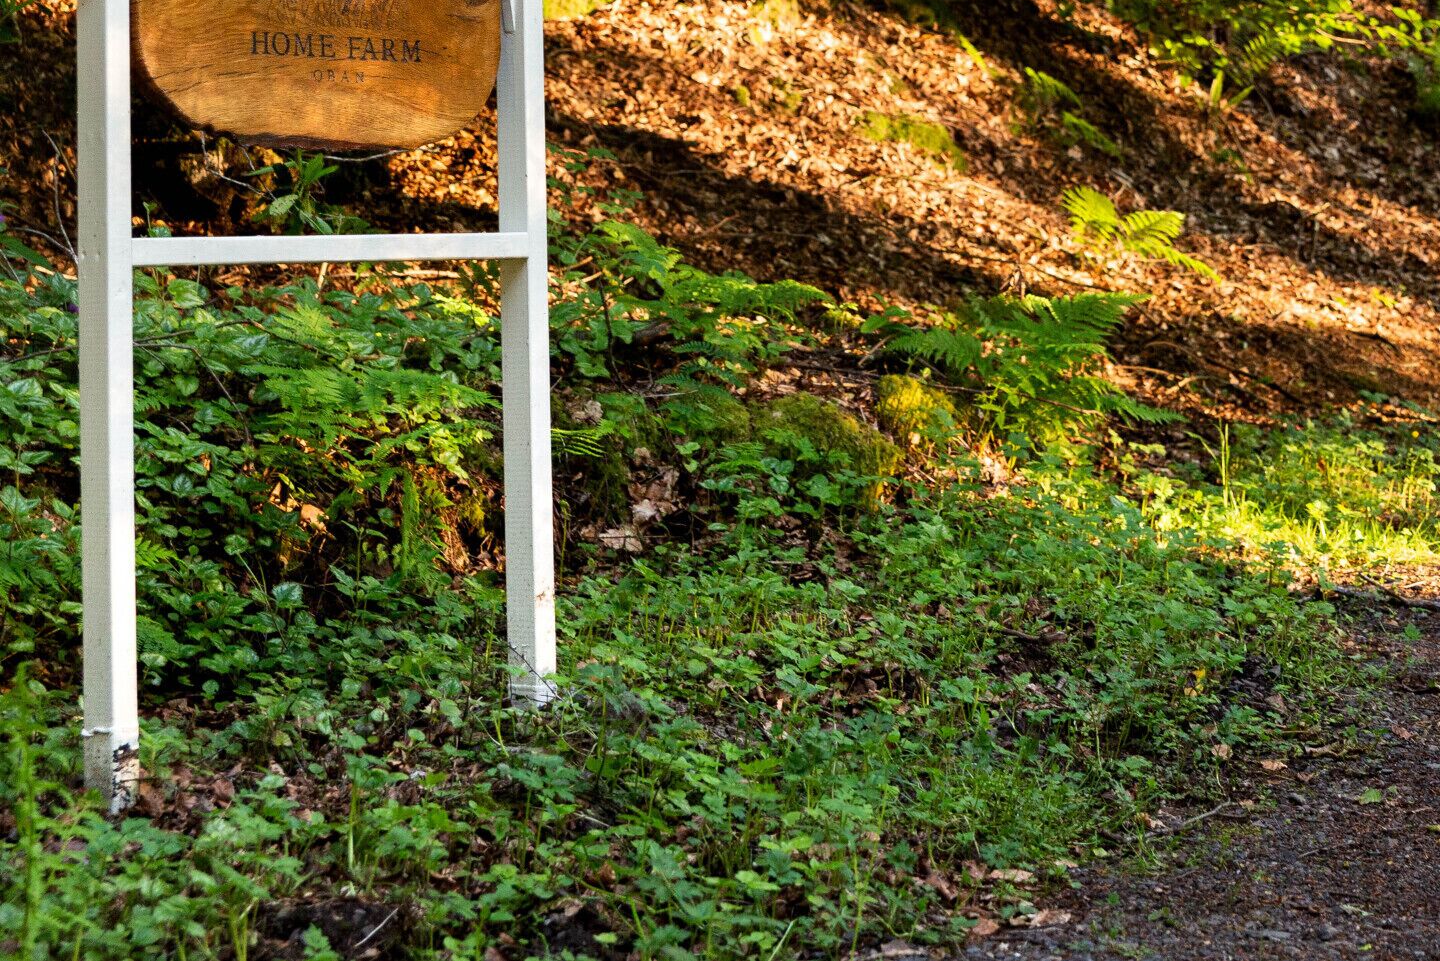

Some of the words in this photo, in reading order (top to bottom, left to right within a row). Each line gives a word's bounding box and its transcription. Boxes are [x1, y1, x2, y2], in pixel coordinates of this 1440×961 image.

[251, 31, 335, 58] HOME
[347, 36, 421, 63] FARM
[312, 69, 365, 83] OBAN
